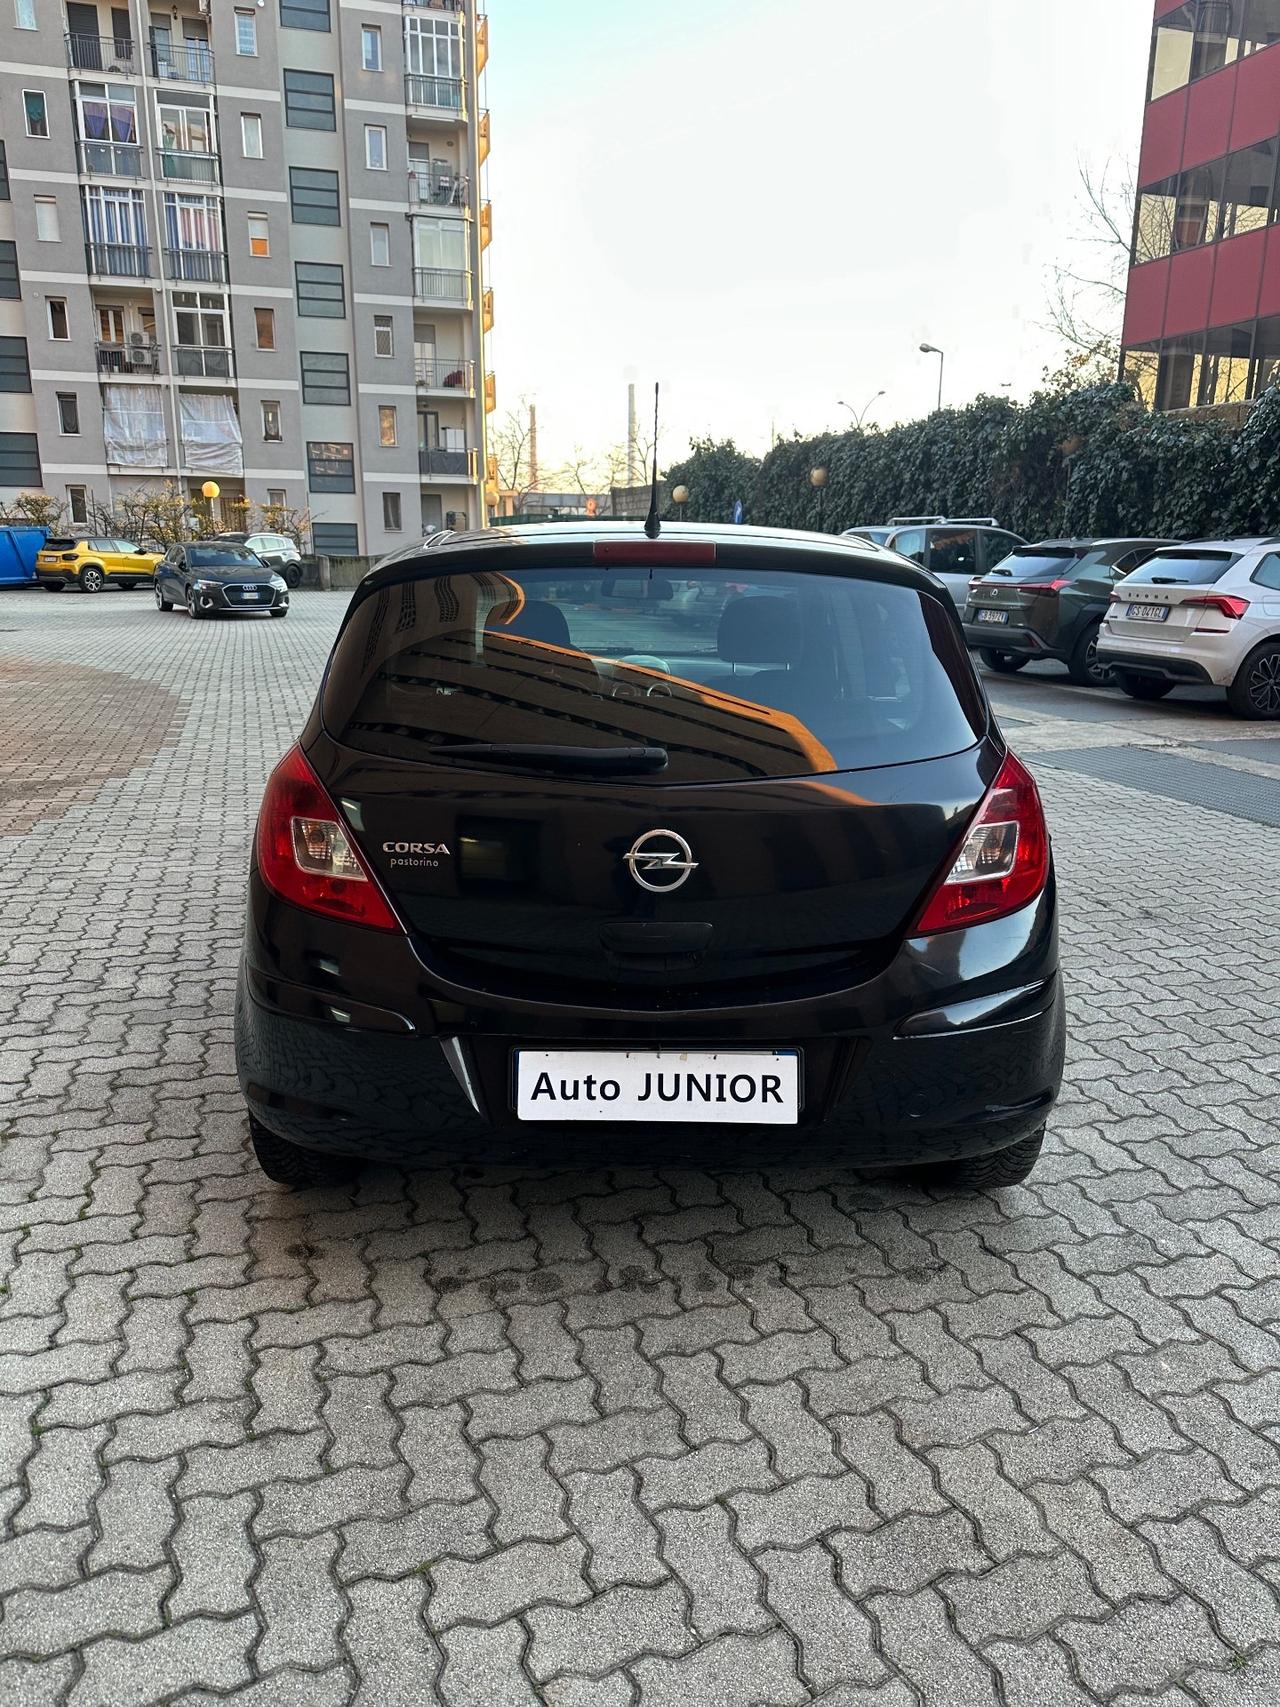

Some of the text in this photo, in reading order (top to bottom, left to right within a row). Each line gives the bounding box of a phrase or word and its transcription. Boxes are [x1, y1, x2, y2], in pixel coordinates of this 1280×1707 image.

[382, 841, 451, 855] CORSA
[390, 857, 439, 868] pastorino
[530, 1072, 784, 1103] Auto JUNIOR
